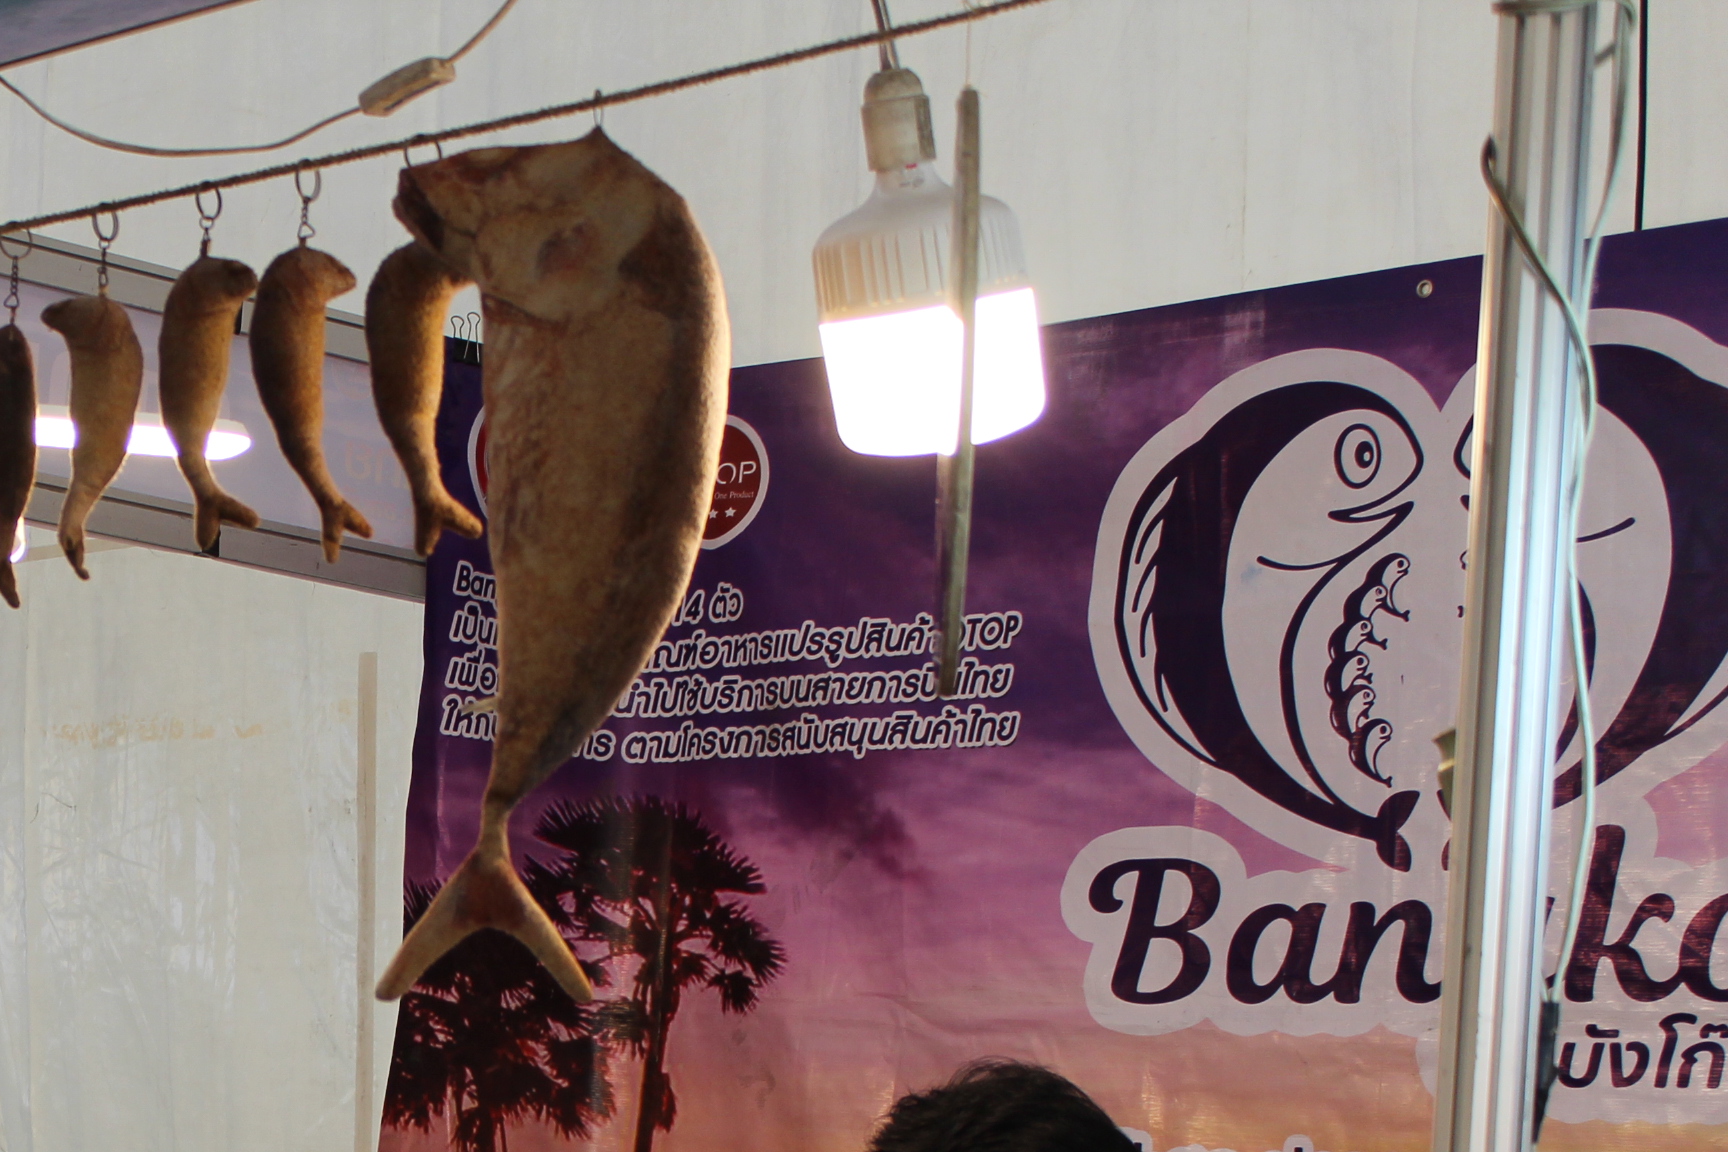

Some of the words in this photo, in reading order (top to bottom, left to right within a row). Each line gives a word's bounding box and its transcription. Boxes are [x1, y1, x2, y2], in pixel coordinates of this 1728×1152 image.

[716, 460, 757, 485] OP
[454, 561, 497, 602] Ban
[709, 583, 744, 624] ตัว
